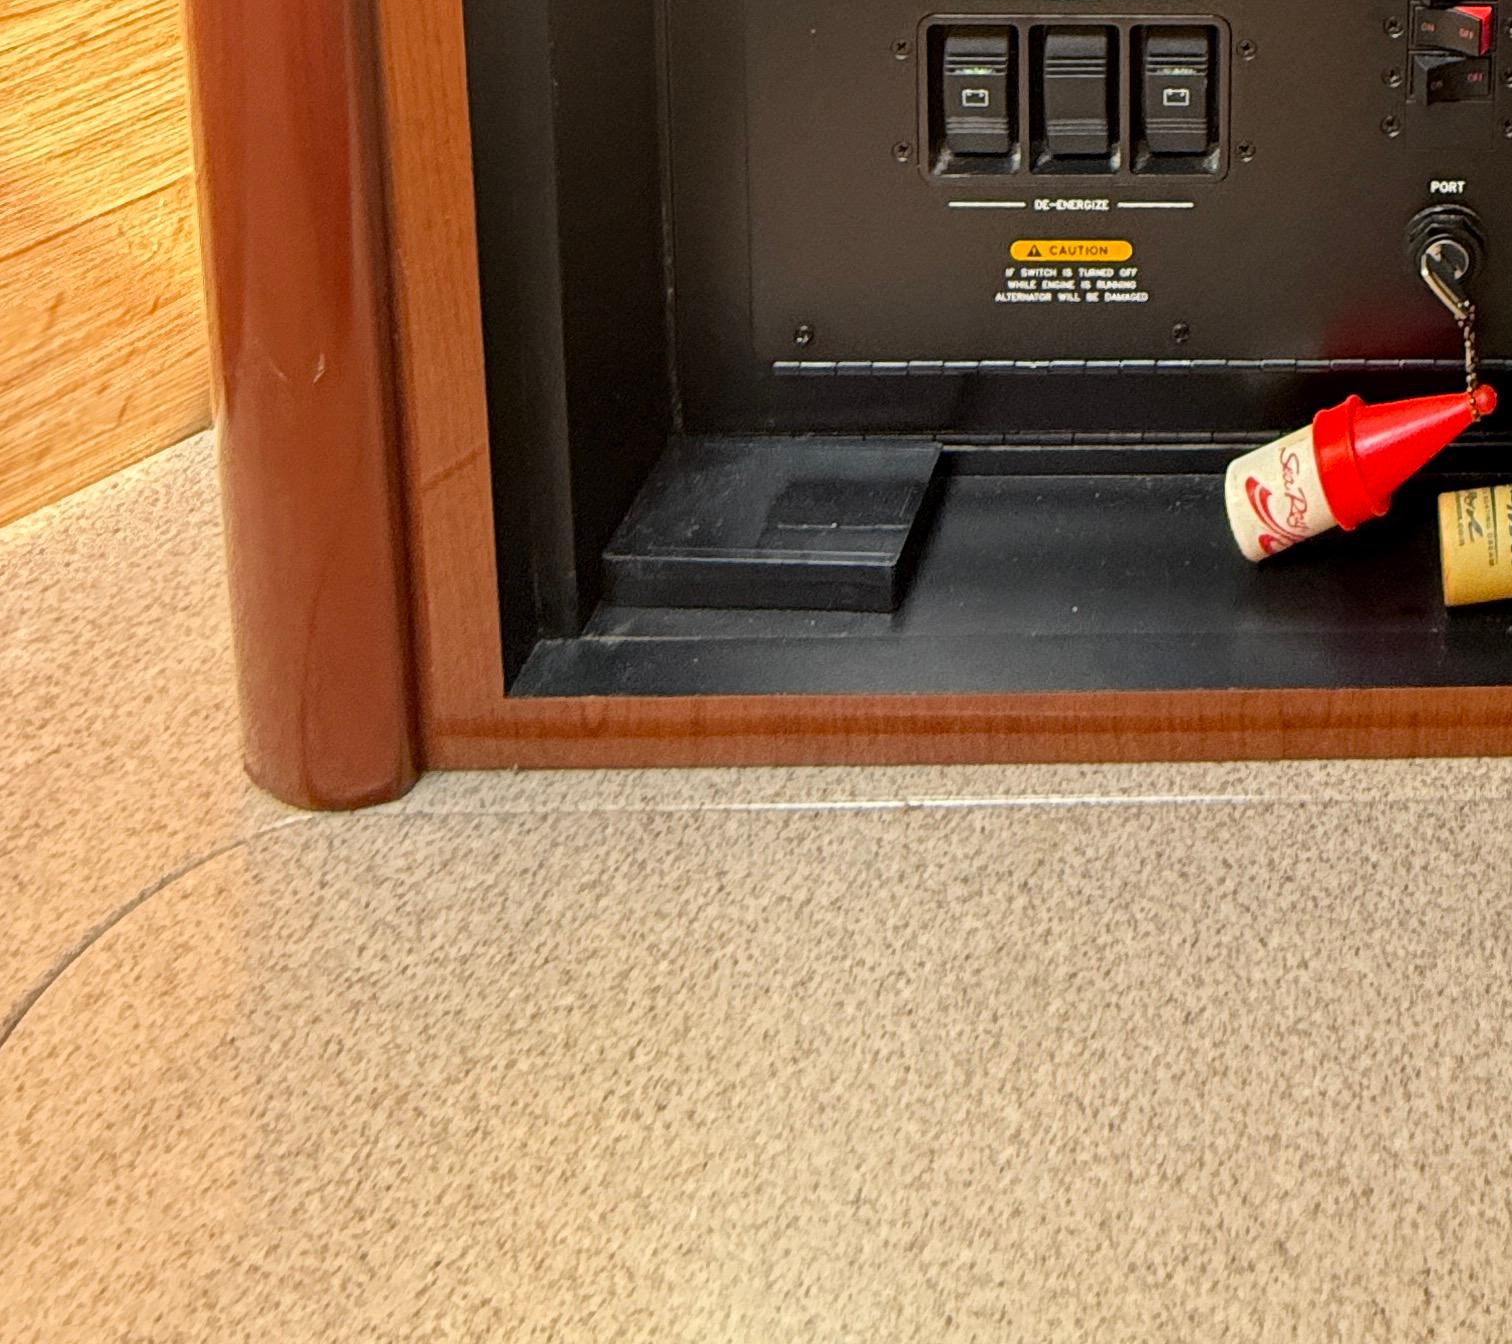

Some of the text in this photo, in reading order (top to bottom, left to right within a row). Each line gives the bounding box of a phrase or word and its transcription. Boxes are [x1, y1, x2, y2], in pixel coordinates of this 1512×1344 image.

[1431, 181, 1465, 193] PORT
[1035, 199, 1109, 210] DE-ENERGIZE
[1049, 245, 1108, 257] CAUTION
[1280, 447, 1313, 530] Sea Ray
